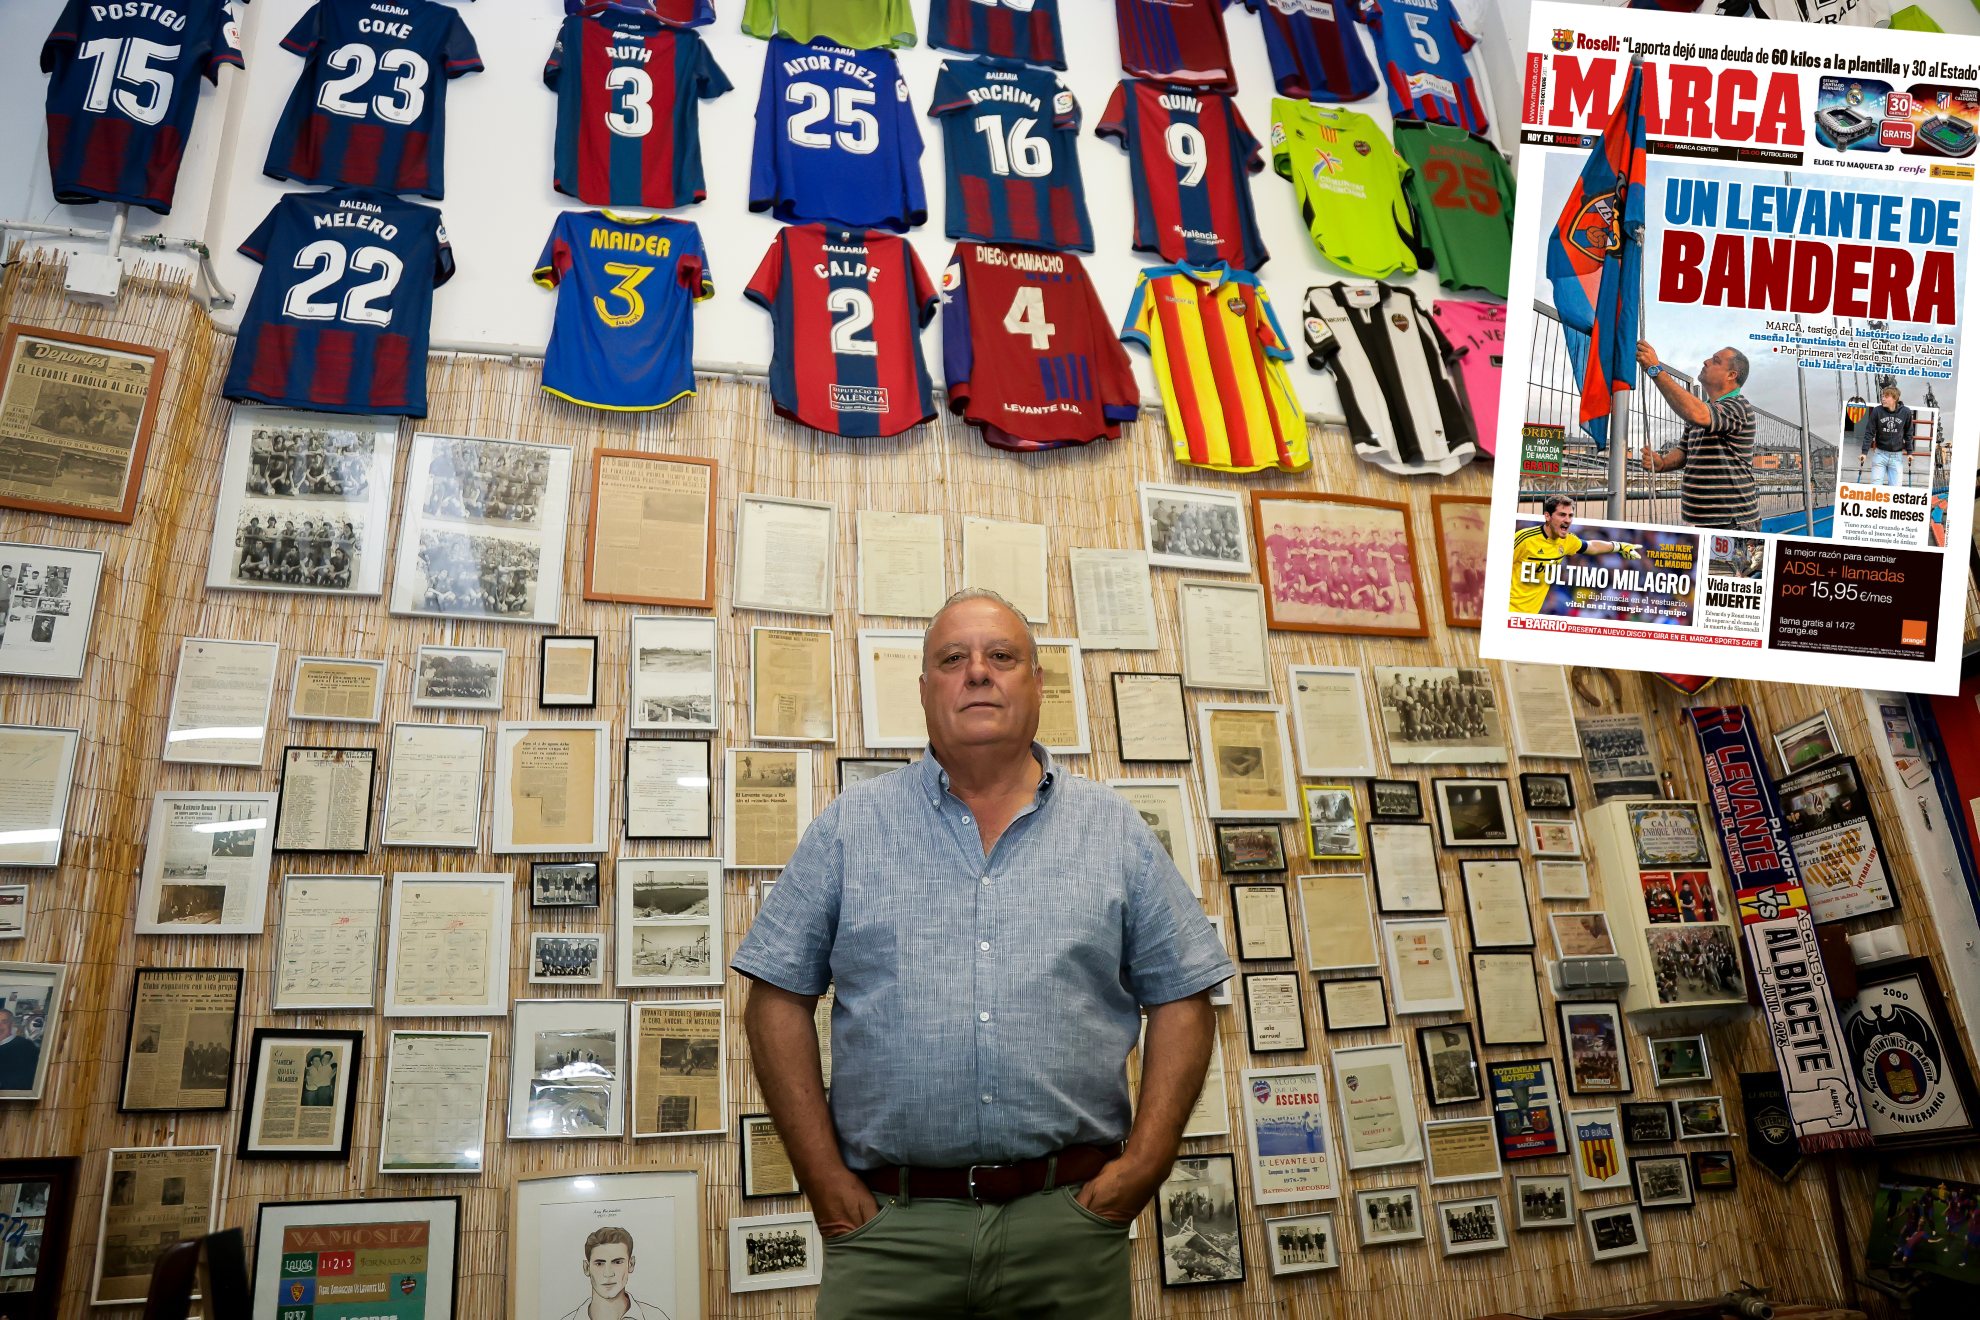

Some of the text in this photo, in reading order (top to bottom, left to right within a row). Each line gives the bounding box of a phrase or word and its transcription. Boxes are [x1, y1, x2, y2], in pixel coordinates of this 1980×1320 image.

[91, 2, 186, 31] POSTIGO
[371, 3, 409, 16] BALEARIA
[358, 18, 413, 39] COKE
[1404, 12, 1440, 64] 5
[605, 46, 652, 63] RUTH
[78, 37, 181, 125] 15
[316, 43, 429, 125] 23
[783, 56, 877, 88] AITOR FDEZ.
[985, 72, 1018, 81] BALEARIA
[605, 66, 653, 137] 3
[967, 85, 1041, 112] ROCHINA
[1158, 94, 1203, 114] QUINI
[786, 81, 879, 154] 25
[975, 115, 1053, 177] 16
[1164, 122, 1207, 187] 9
[1422, 158, 1501, 217] 25
[339, 200, 382, 213] BALEARIA
[313, 213, 399, 240] MELERO
[590, 228, 671, 257] MAIDER
[822, 244, 869, 255] BALEARIA
[814, 260, 880, 282] CALPE
[975, 245, 1064, 273] DIEGO CAMACHO
[282, 240, 403, 327] 22
[594, 262, 655, 327] 3
[827, 287, 878, 356] 2
[1003, 286, 1055, 350] 4
[34, 343, 109, 368] Deportes
[16, 363, 26, 374] EL
[31, 366, 69, 382] LEVANTE
[1004, 403, 1082, 415] LEVANTE U.D.
[1704, 754, 1746, 875] ESTADIO CIUTAT DE VALENCIA
[1715, 745, 1780, 873] LEVANTE
[1843, 815, 1867, 827] HONOR
[1642, 828, 1671, 837] ENRIQUE
[1769, 817, 1800, 887] PLAYOFF
[1757, 887, 1790, 920] VS
[1796, 908, 1826, 987] ASCENSO
[1763, 928, 1835, 1074] ALBACETE
[1883, 987, 1909, 1000] 2000
[1762, 983, 1781, 1013] JUNIO
[1773, 1022, 1790, 1047] 2023
[1866, 1036, 1915, 1065] LLEVANTINISTA
[1493, 1065, 1540, 1075] TOTTENHAM
[1502, 1073, 1535, 1082] HOTSPUR
[1276, 1093, 1319, 1106] ASCENSO
[1830, 1088, 1843, 1116] ALBACETE
[1872, 1091, 1946, 1124] 25 ANIVERSARIO
[1591, 1126, 1610, 1137] BUÑOL
[1269, 1157, 1308, 1167] LEVANTE
